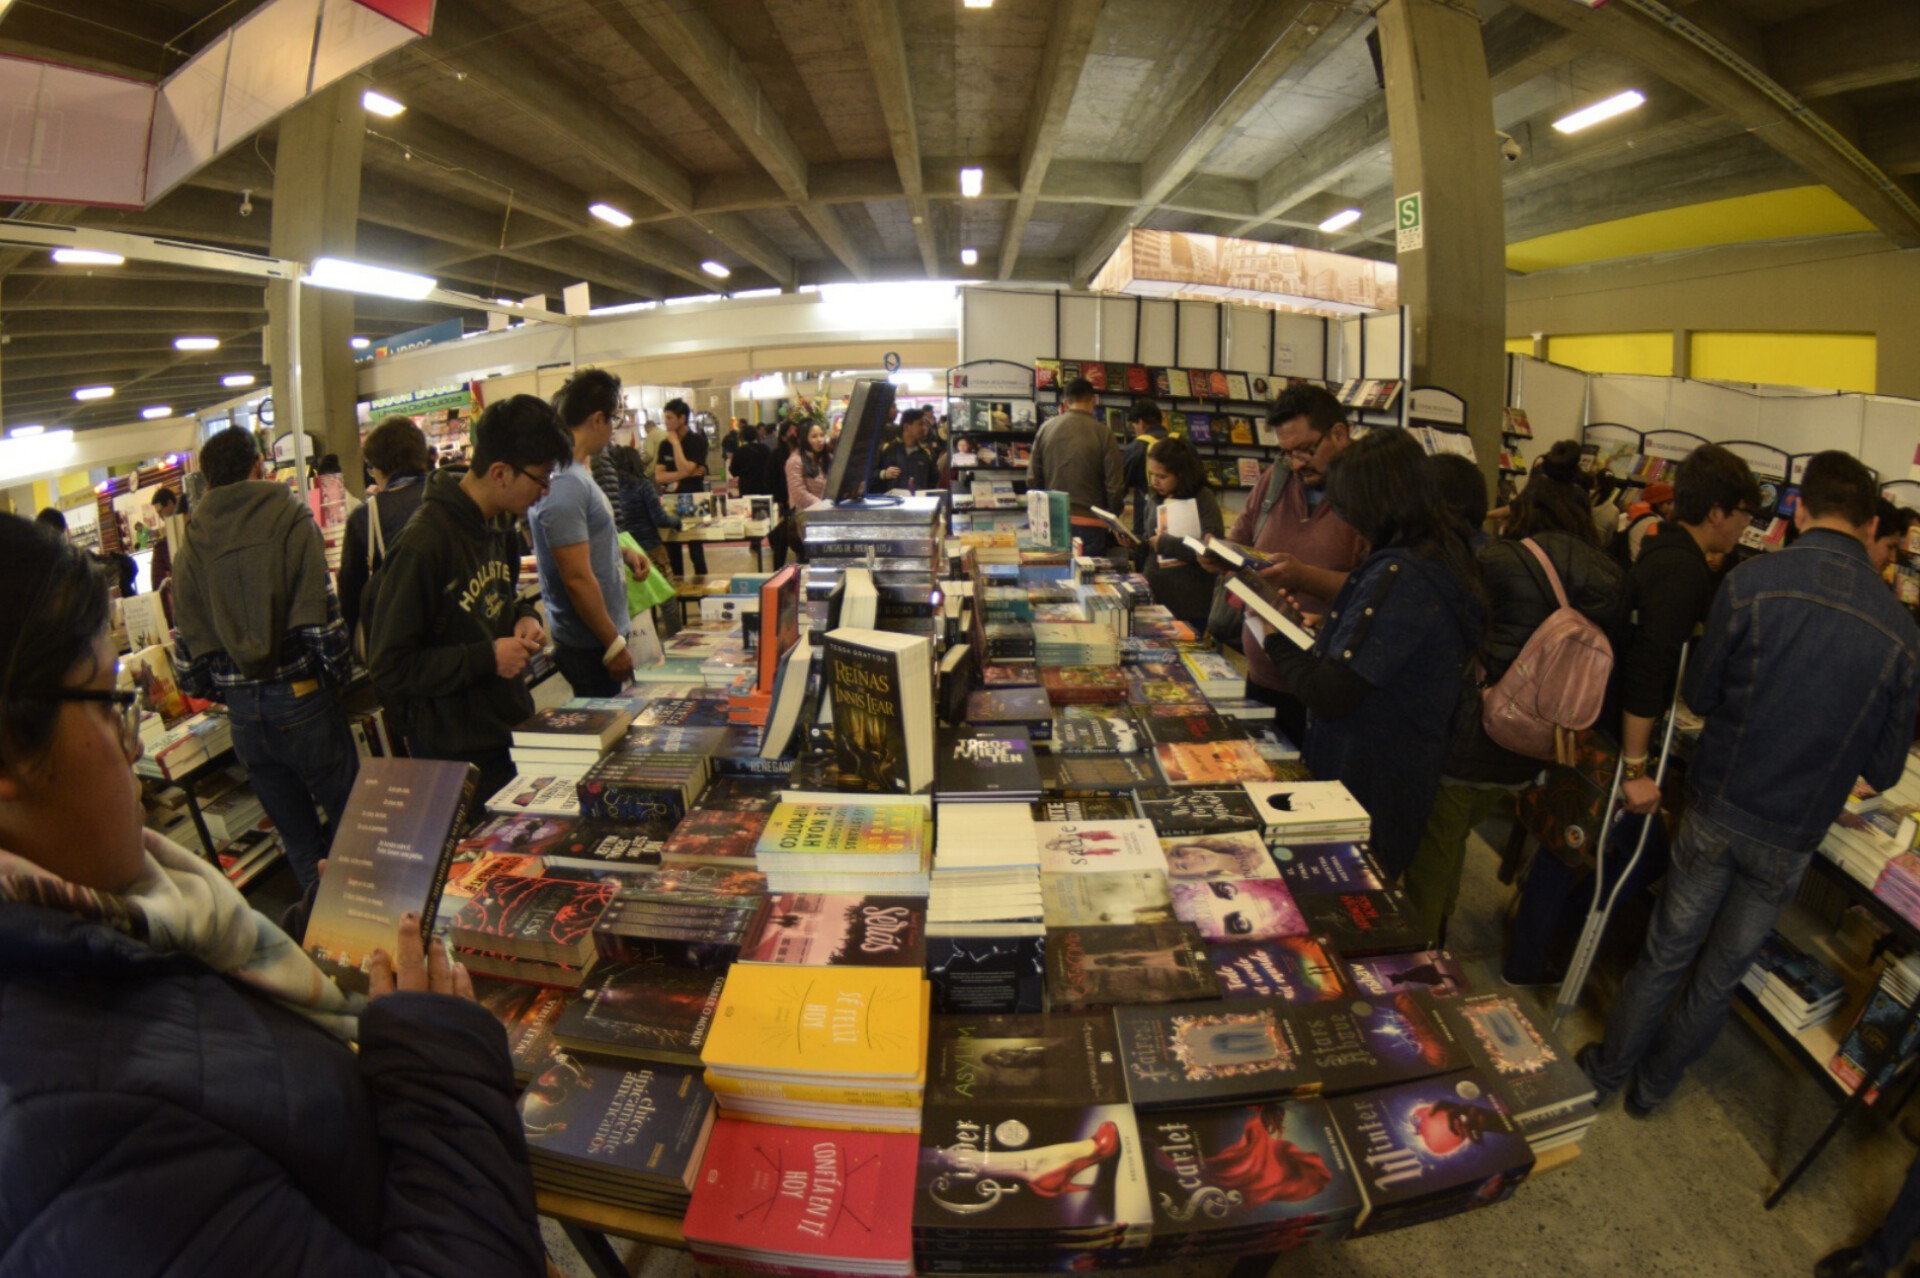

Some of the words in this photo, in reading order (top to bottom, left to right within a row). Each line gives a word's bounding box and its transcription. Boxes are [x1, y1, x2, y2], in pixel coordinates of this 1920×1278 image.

[1402, 200, 1416, 226] S
[830, 643, 851, 654] TESSA
[853, 649, 888, 663] GRATTON
[834, 659, 889, 693] REINAS
[834, 683, 866, 709] INNIS
[866, 692, 895, 717] LEAR
[814, 806, 833, 816] DE
[887, 807, 907, 849] DAVID
[802, 819, 828, 847] NOAH
[1061, 825, 1088, 866] sadie
[860, 905, 909, 954] Serás
[836, 990, 864, 1007] SÉ
[689, 1016, 709, 1048] MORIR
[803, 1004, 828, 1028] HOY
[587, 1071, 634, 1154] americanos
[623, 1096, 657, 1145] chicos
[1354, 1101, 1424, 1191] Winter
[781, 1170, 808, 1199] HOY
[812, 1142, 842, 1193] CONFÍA
[1157, 1121, 1243, 1222] Scarlet
[806, 1196, 833, 1217] EN
